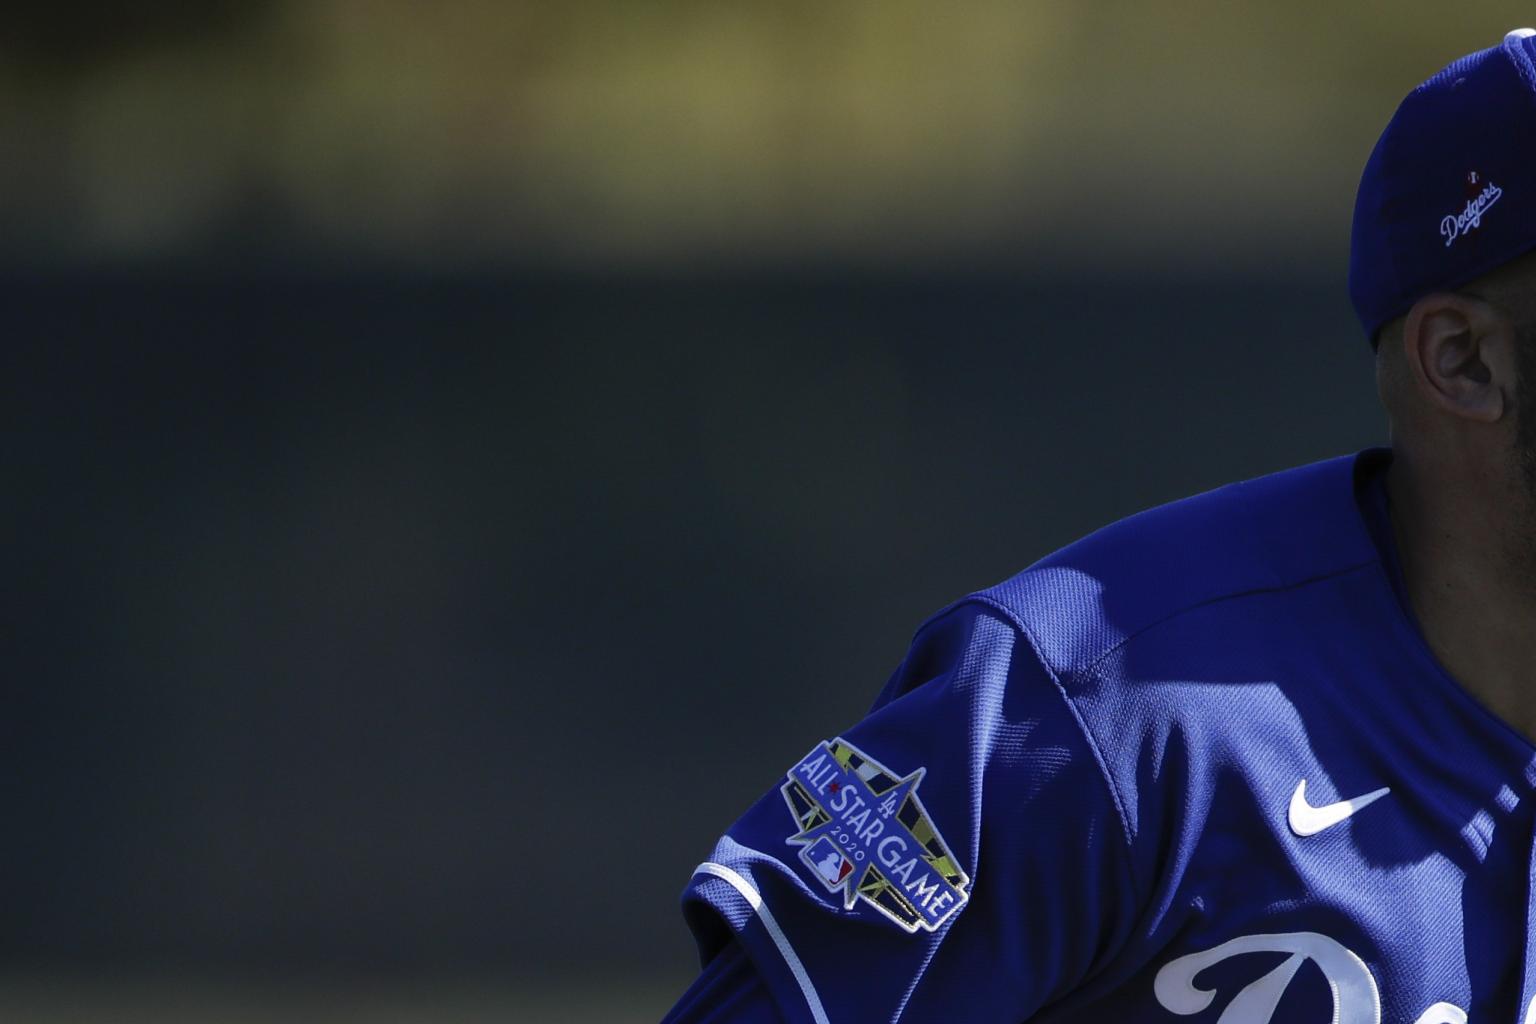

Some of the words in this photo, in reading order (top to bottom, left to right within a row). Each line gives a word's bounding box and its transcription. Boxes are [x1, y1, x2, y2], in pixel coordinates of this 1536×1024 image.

[800, 754, 838, 796] ALL
[830, 785, 884, 846] STAR
[877, 836, 953, 917] GAME
[830, 826, 865, 861] 2020
